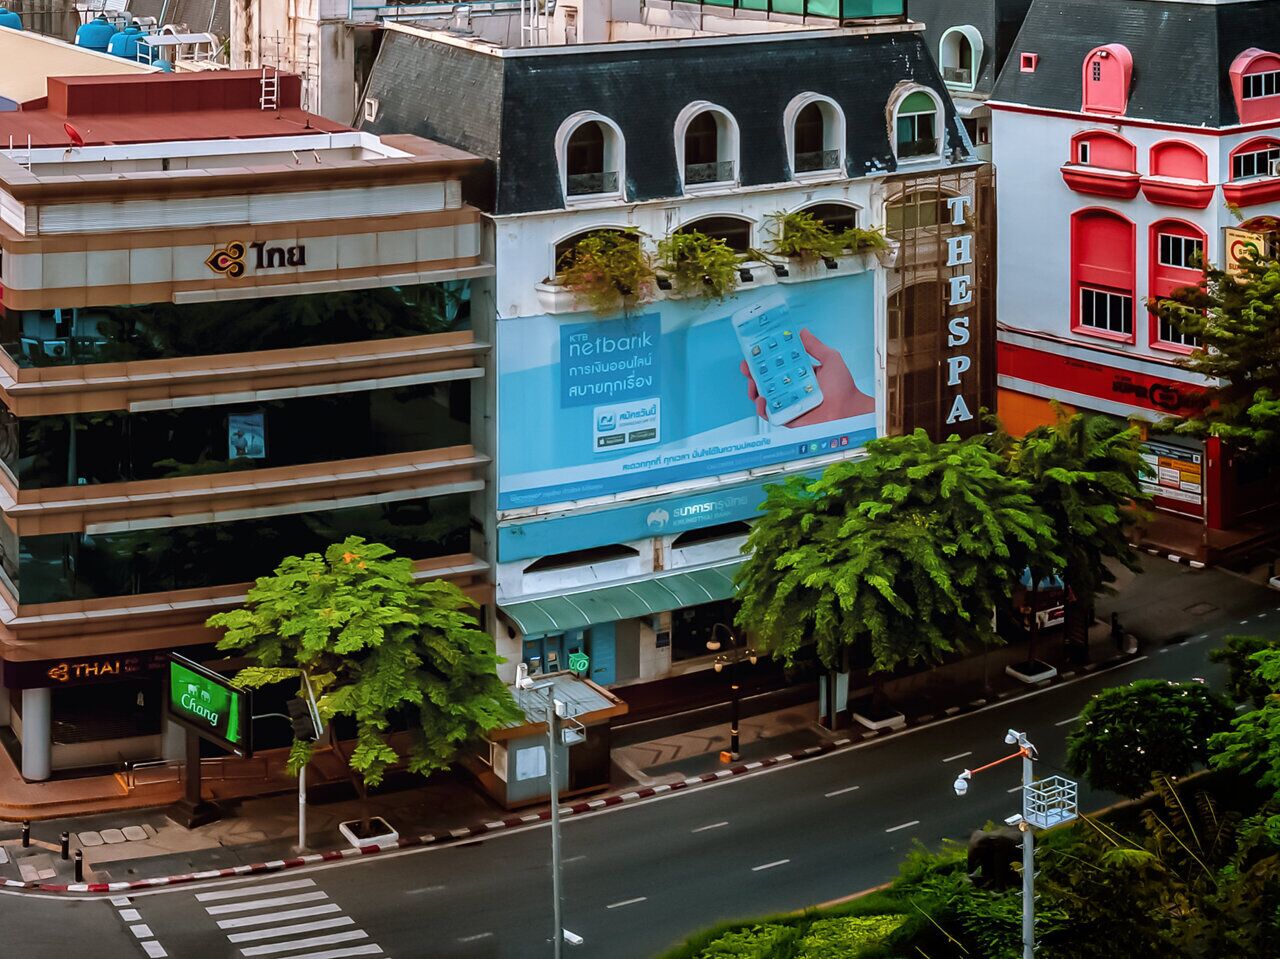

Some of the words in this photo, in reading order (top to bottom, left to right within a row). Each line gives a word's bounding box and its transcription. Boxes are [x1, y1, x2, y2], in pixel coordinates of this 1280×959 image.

[248, 241, 306, 269] ไทย
[946, 195, 973, 306] THE
[569, 334, 589, 343] KTB
[569, 331, 653, 357] netbank
[569, 353, 652, 376] การเงินออนไลน์
[946, 316, 974, 424] SPA
[569, 370, 653, 397] สบายทุกเรื่อง
[74, 662, 121, 678] THAI
[181, 693, 219, 727] Chang
